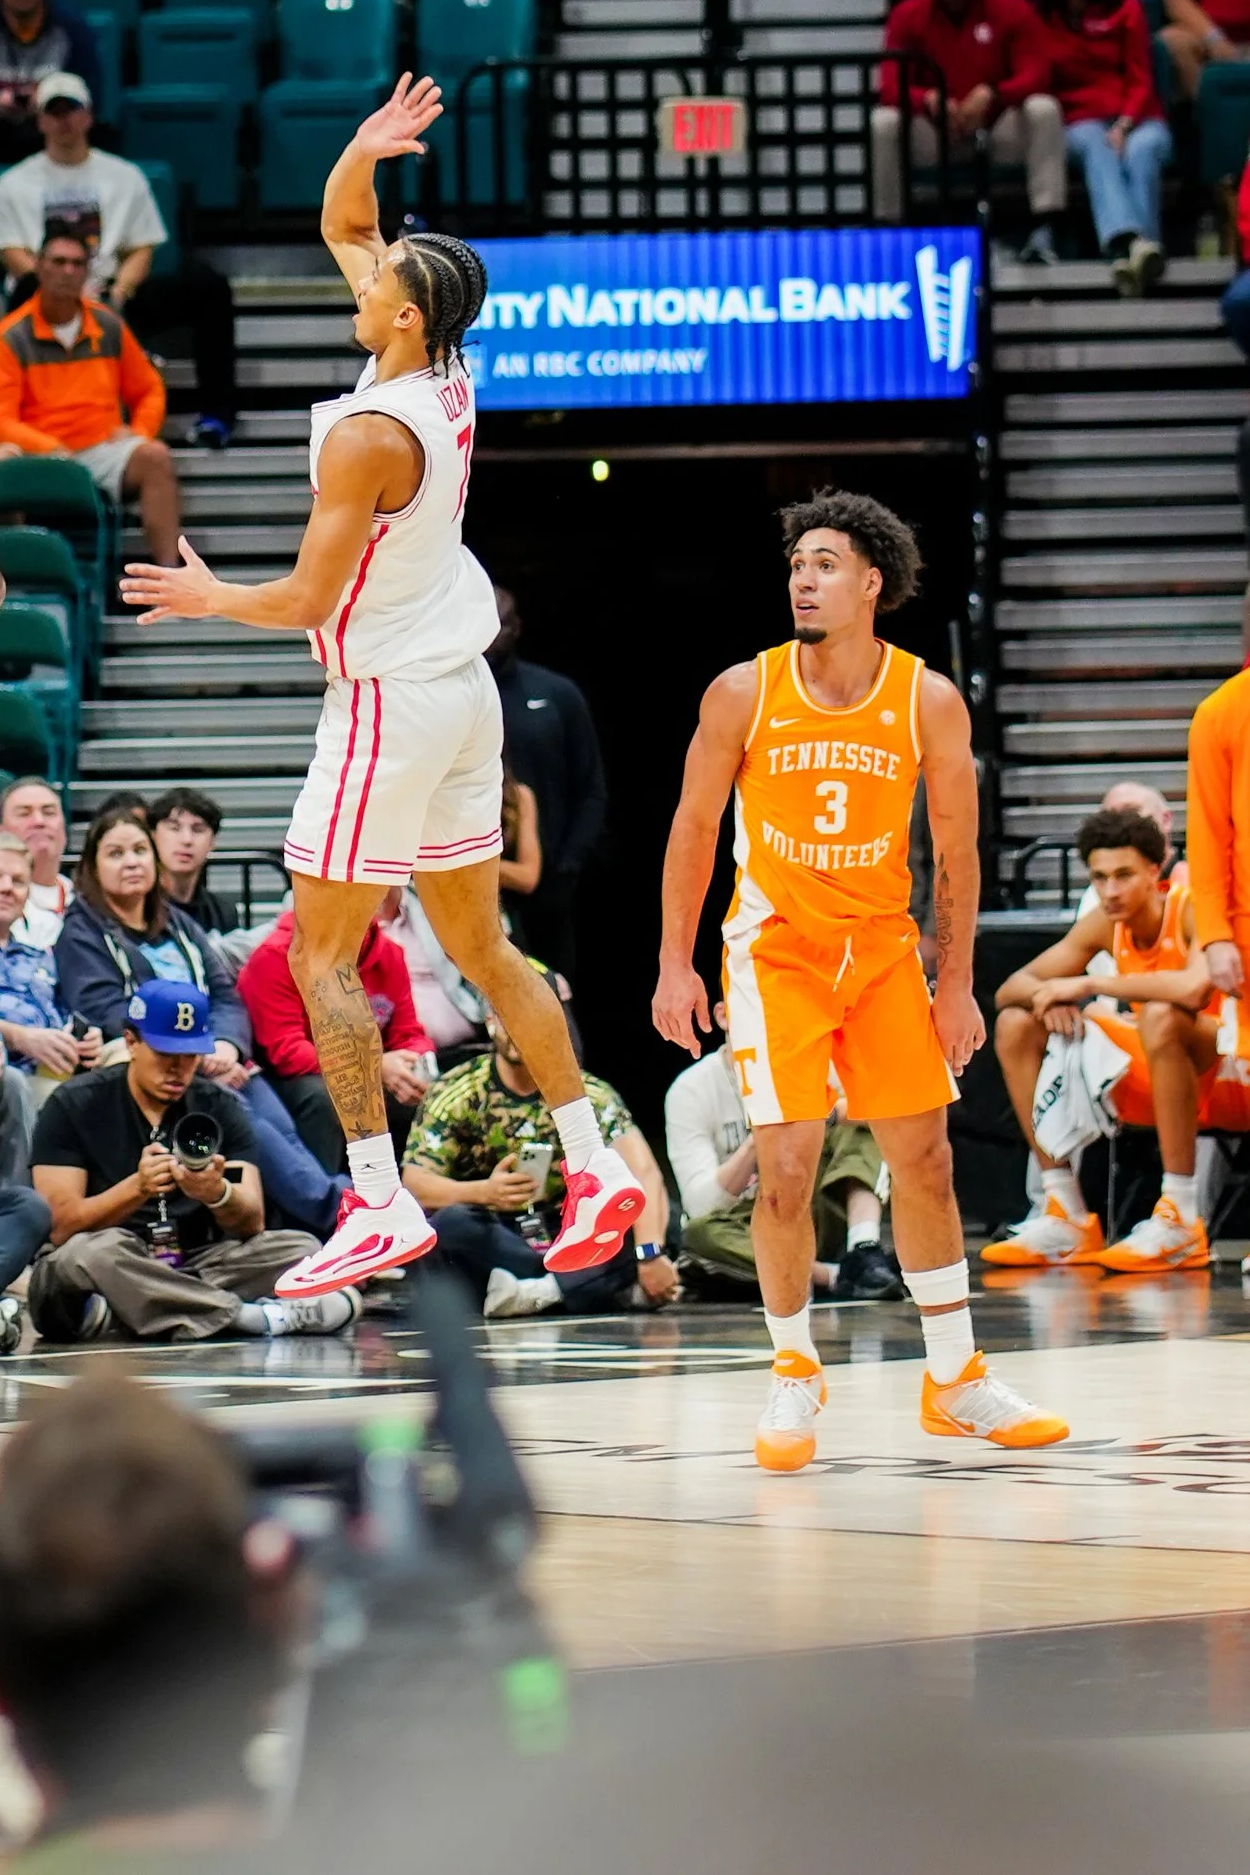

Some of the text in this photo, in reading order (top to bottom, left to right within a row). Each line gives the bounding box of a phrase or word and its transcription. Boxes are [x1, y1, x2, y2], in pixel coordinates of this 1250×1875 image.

[673, 103, 734, 154] EXIT
[466, 276, 912, 331] ITY NATIONAL BANK
[493, 347, 707, 378] AN RBC COMPANY
[451, 422, 472, 524] 7
[767, 741, 901, 781] TENNESSEE
[813, 780, 848, 835] 3
[761, 820, 893, 871] VOLUNTEERS
[174, 1001, 195, 1032] B
[733, 1047, 756, 1097] T
